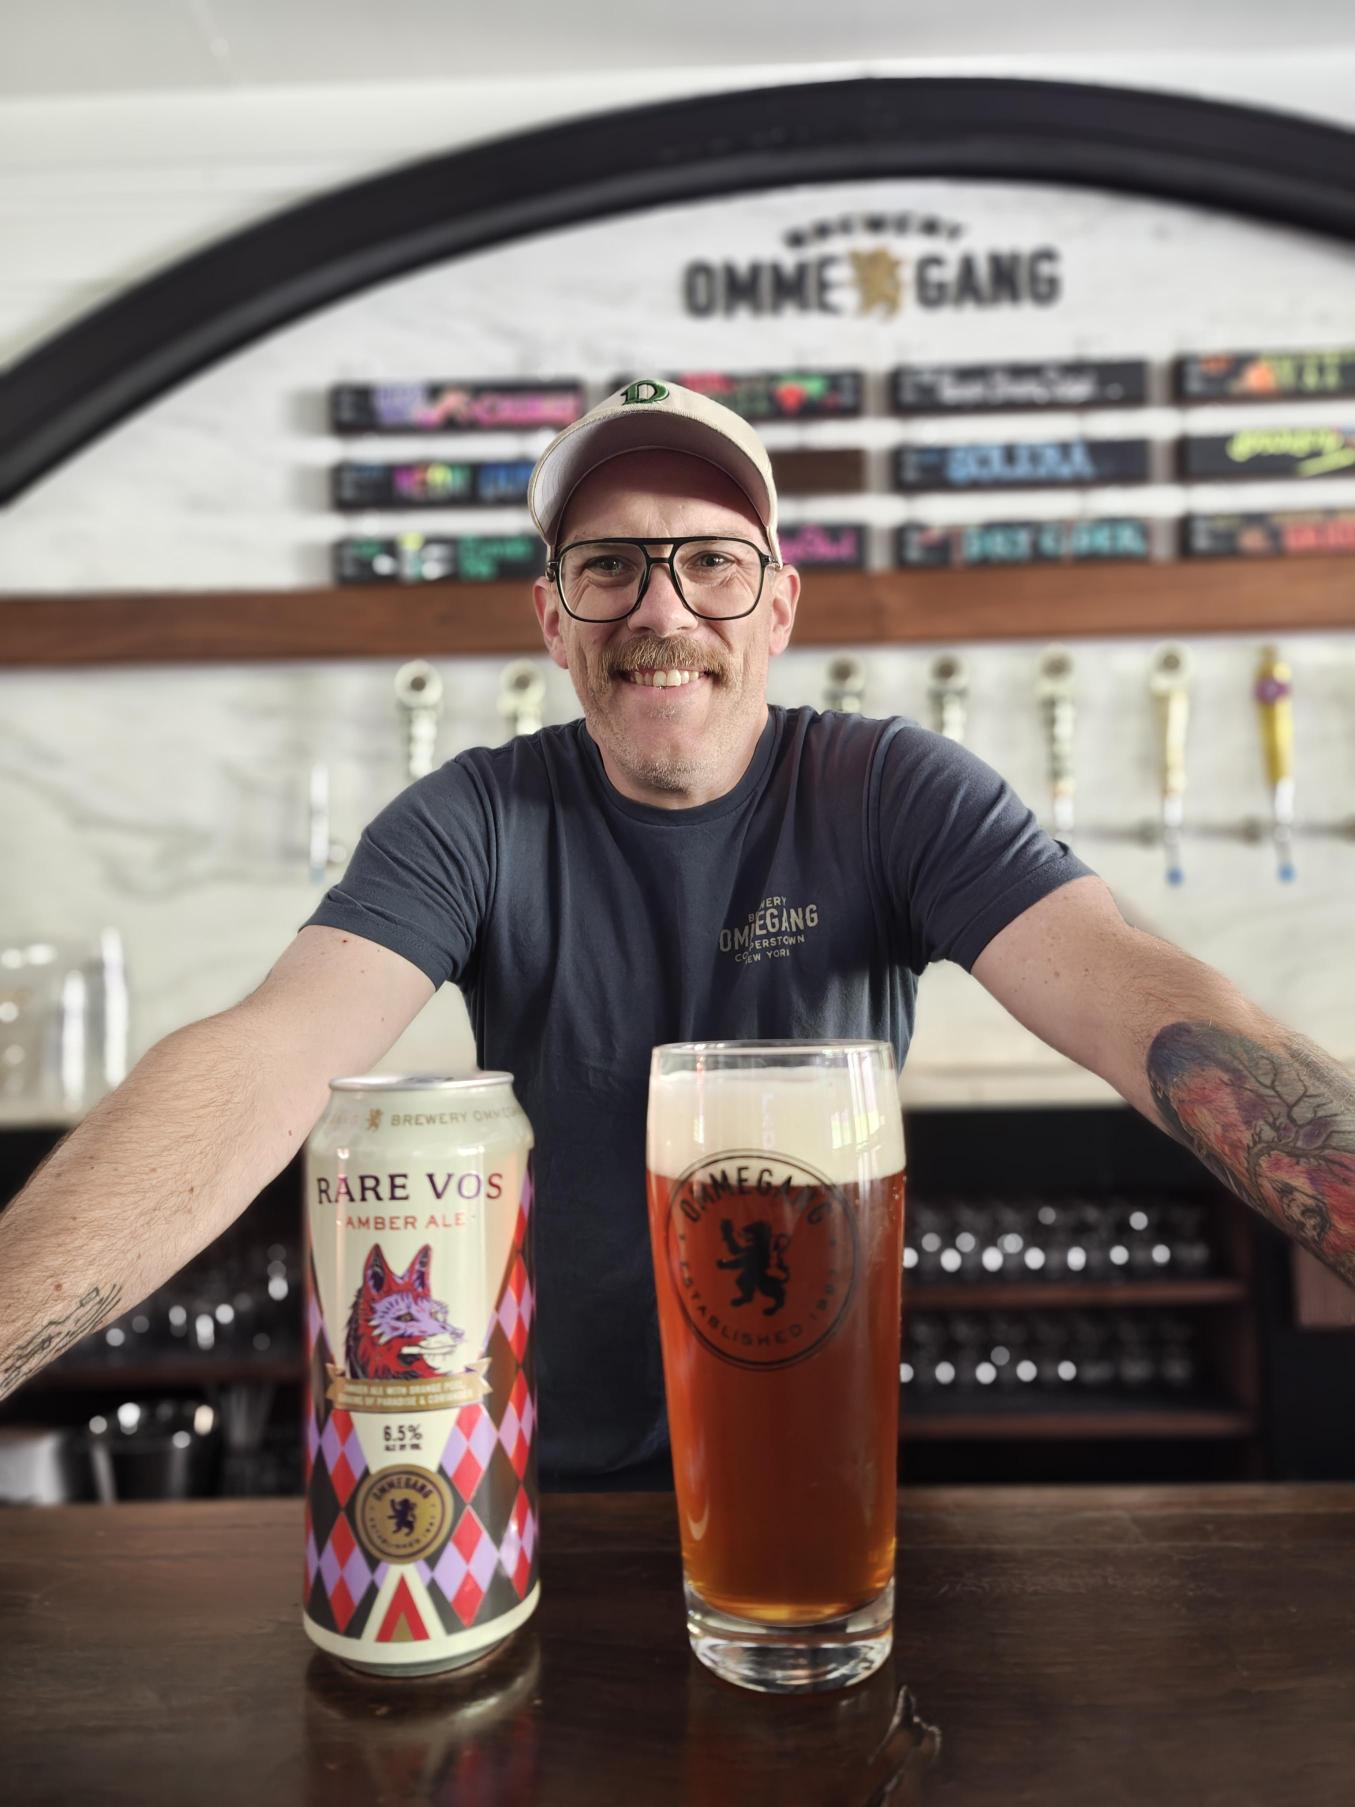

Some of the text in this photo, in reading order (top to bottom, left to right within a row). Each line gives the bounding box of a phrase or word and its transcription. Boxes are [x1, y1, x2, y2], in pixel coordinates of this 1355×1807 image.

[683, 246, 1060, 318] OMME GANG
[621, 379, 670, 405] D
[720, 904, 819, 952] OMEGANG
[390, 1110, 468, 1127] BREWERY
[317, 1172, 504, 1205] RARE VOS
[345, 1211, 466, 1231] AMBER ALE
